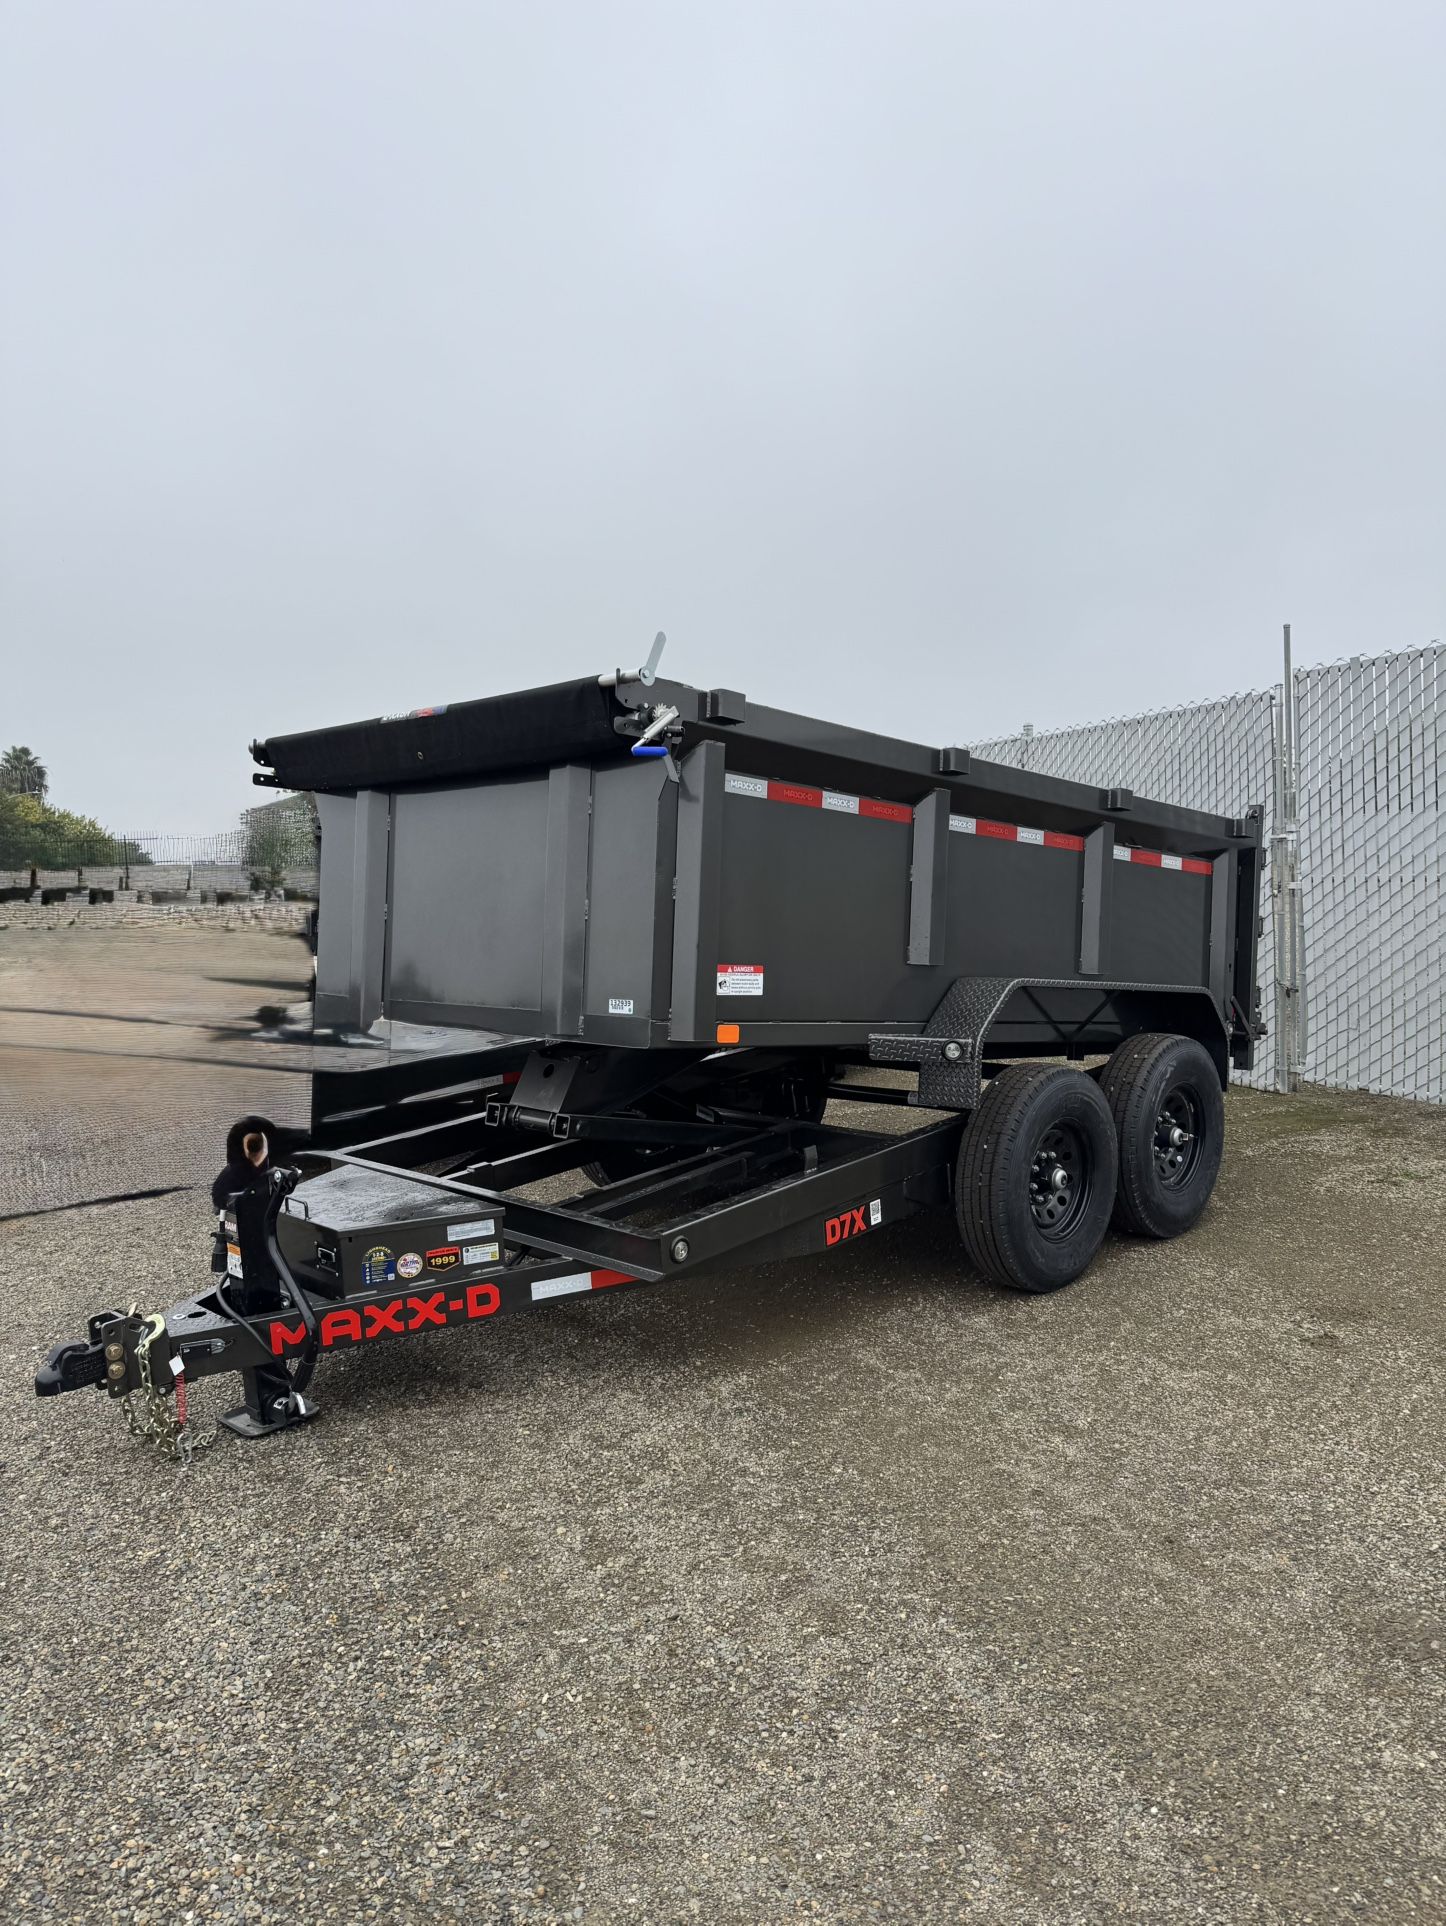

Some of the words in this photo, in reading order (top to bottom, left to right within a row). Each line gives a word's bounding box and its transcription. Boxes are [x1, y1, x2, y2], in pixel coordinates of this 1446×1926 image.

[730, 779, 762, 792] MAXX-D
[783, 789, 812, 801] MAXX-D
[827, 797, 855, 809] MAXX-D
[825, 1205, 867, 1246] D7X
[430, 1255, 456, 1266] 1999
[539, 1278, 584, 1295] MAXX-D
[269, 1283, 500, 1356] MAXX-D
